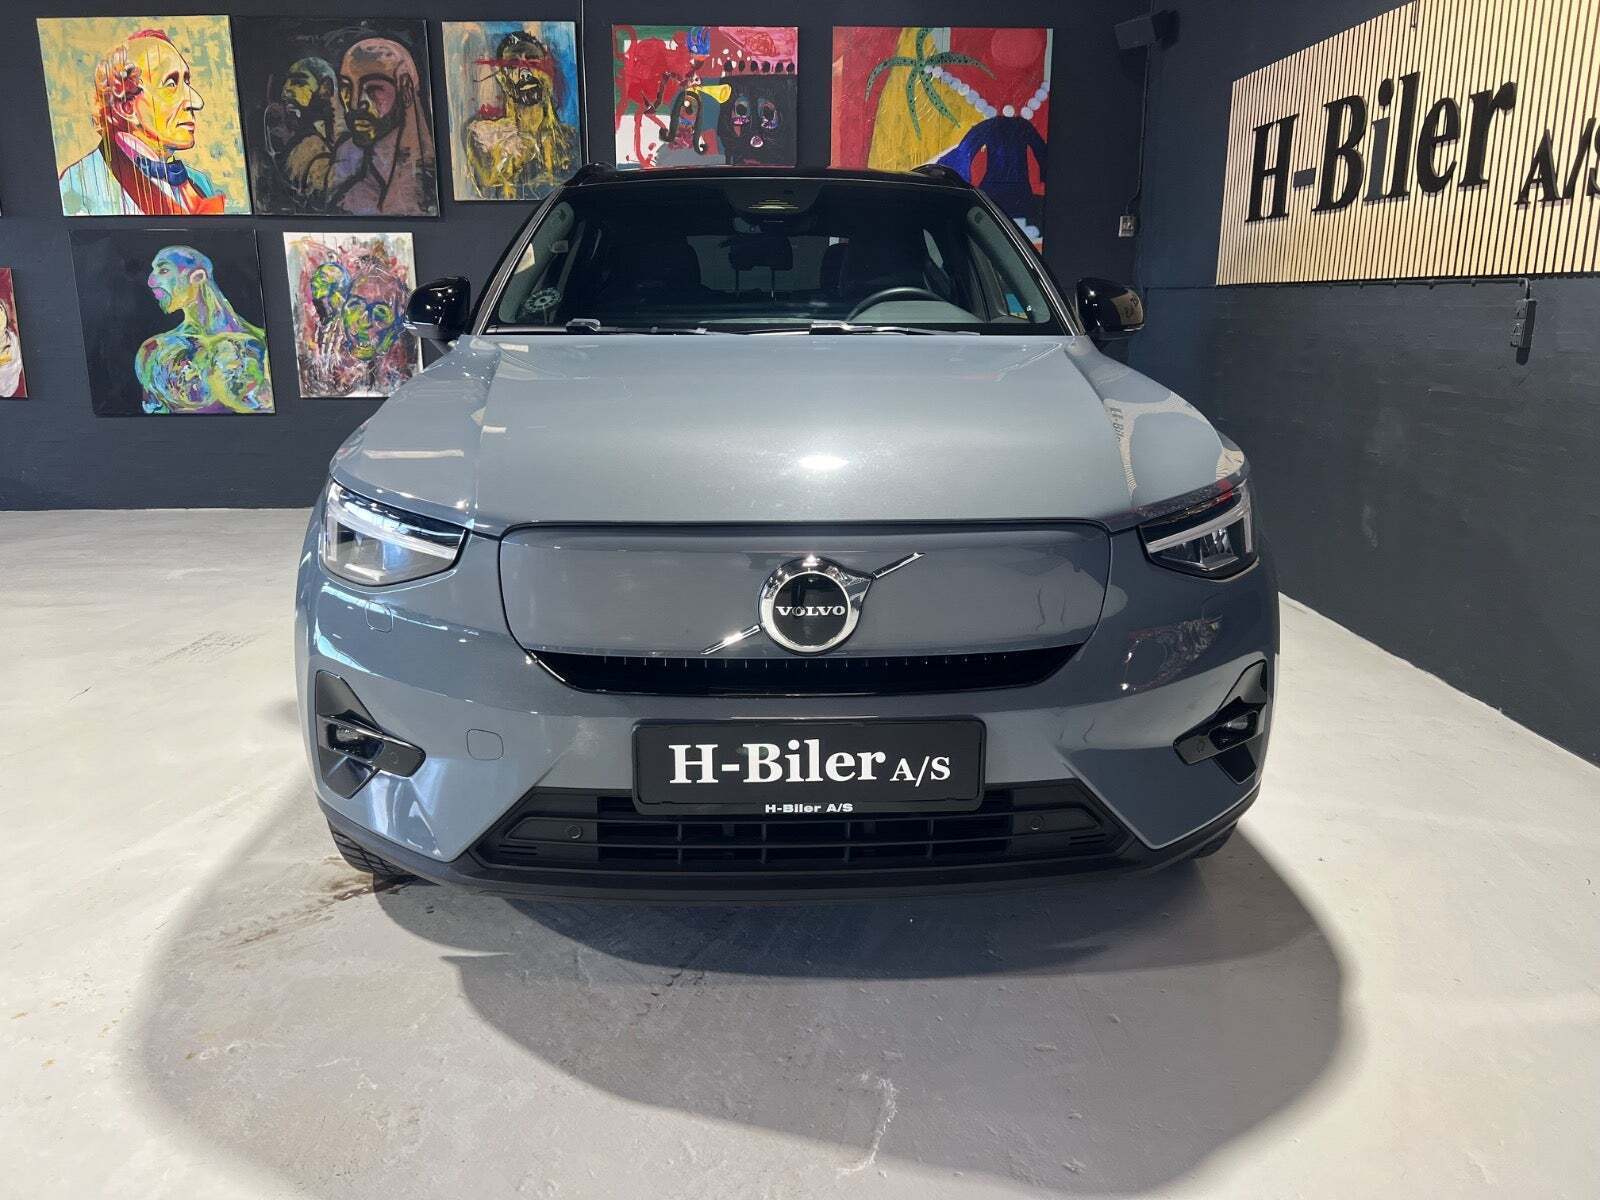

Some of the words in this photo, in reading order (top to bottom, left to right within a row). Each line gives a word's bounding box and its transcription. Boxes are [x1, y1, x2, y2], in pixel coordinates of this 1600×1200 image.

[1244, 71, 1518, 224] H-Biler
[775, 605, 846, 616] VOLVO
[668, 738, 887, 784] H-Biler
[889, 756, 952, 788] A/S
[764, 803, 822, 814] H-Biler
[825, 803, 854, 813] A/S
